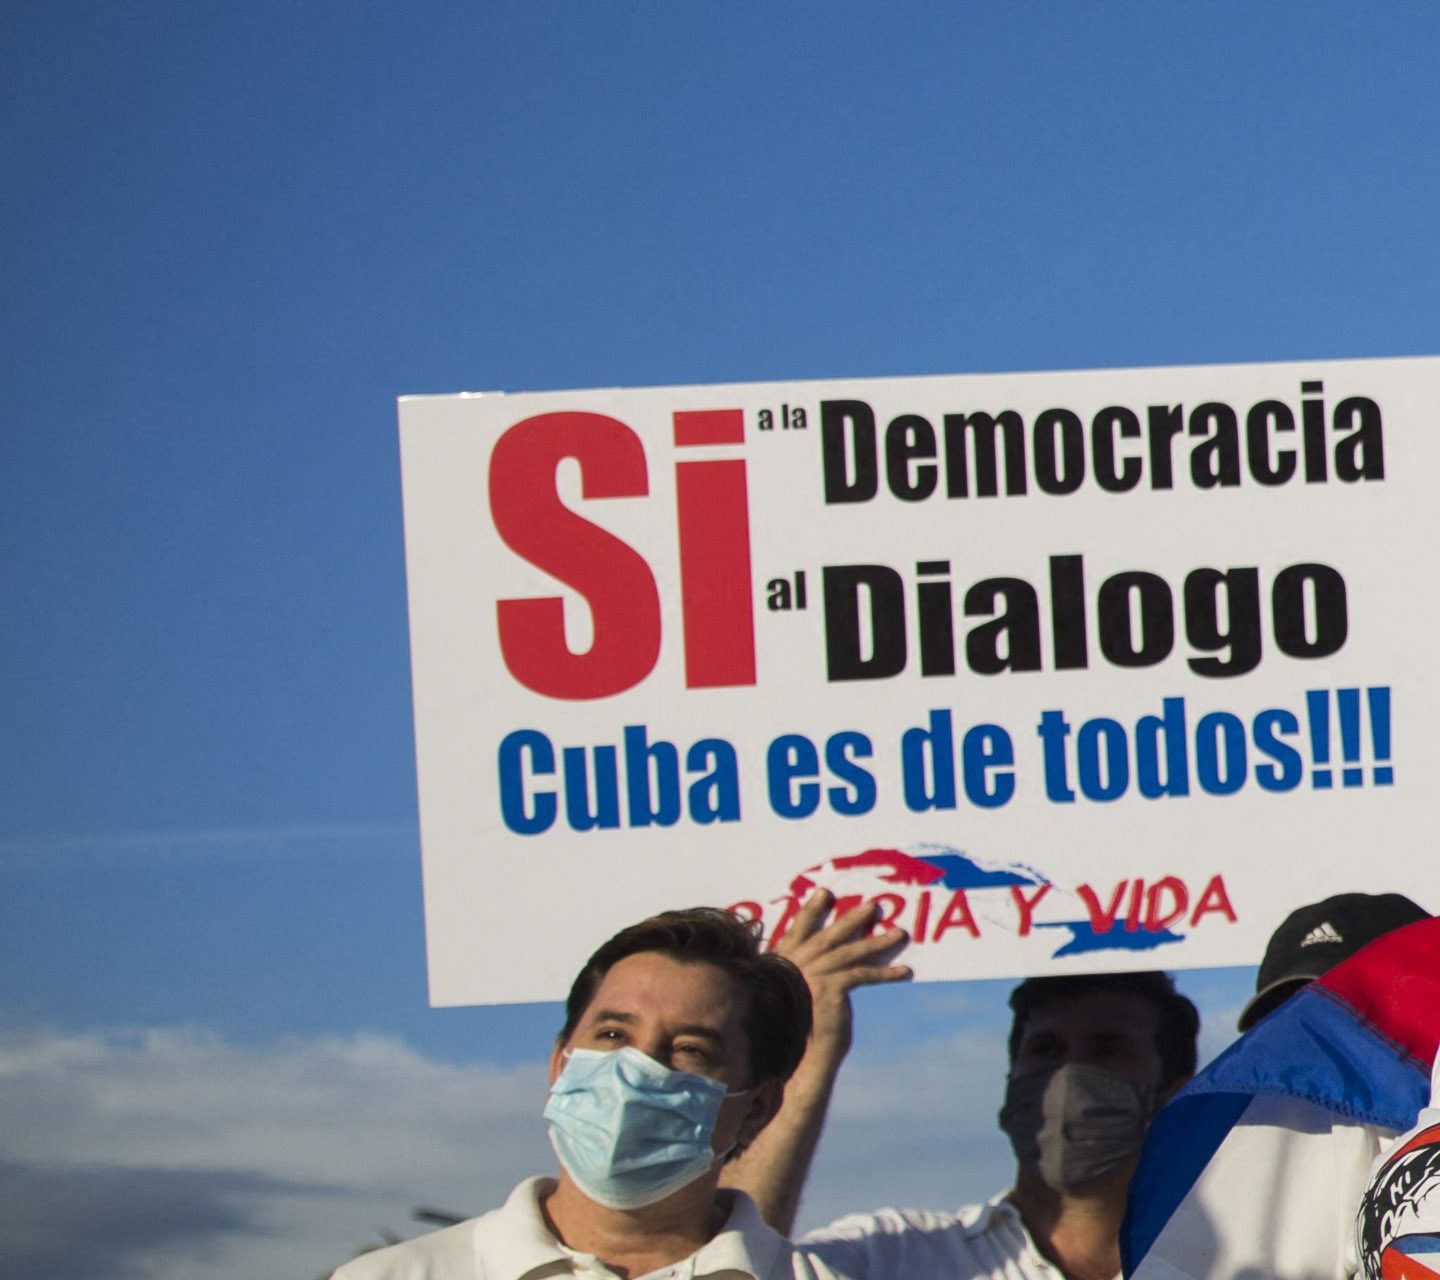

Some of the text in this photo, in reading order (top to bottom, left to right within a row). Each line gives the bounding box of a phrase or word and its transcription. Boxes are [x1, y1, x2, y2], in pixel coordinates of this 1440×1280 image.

[758, 380, 1385, 505] a la Democracia
[489, 408, 758, 701] Si
[767, 554, 1348, 683] al Dialogo
[497, 686, 1394, 836] Cuba es de todos!!!
[1009, 882, 1052, 937] Y
[1075, 874, 1238, 934] VIDA
